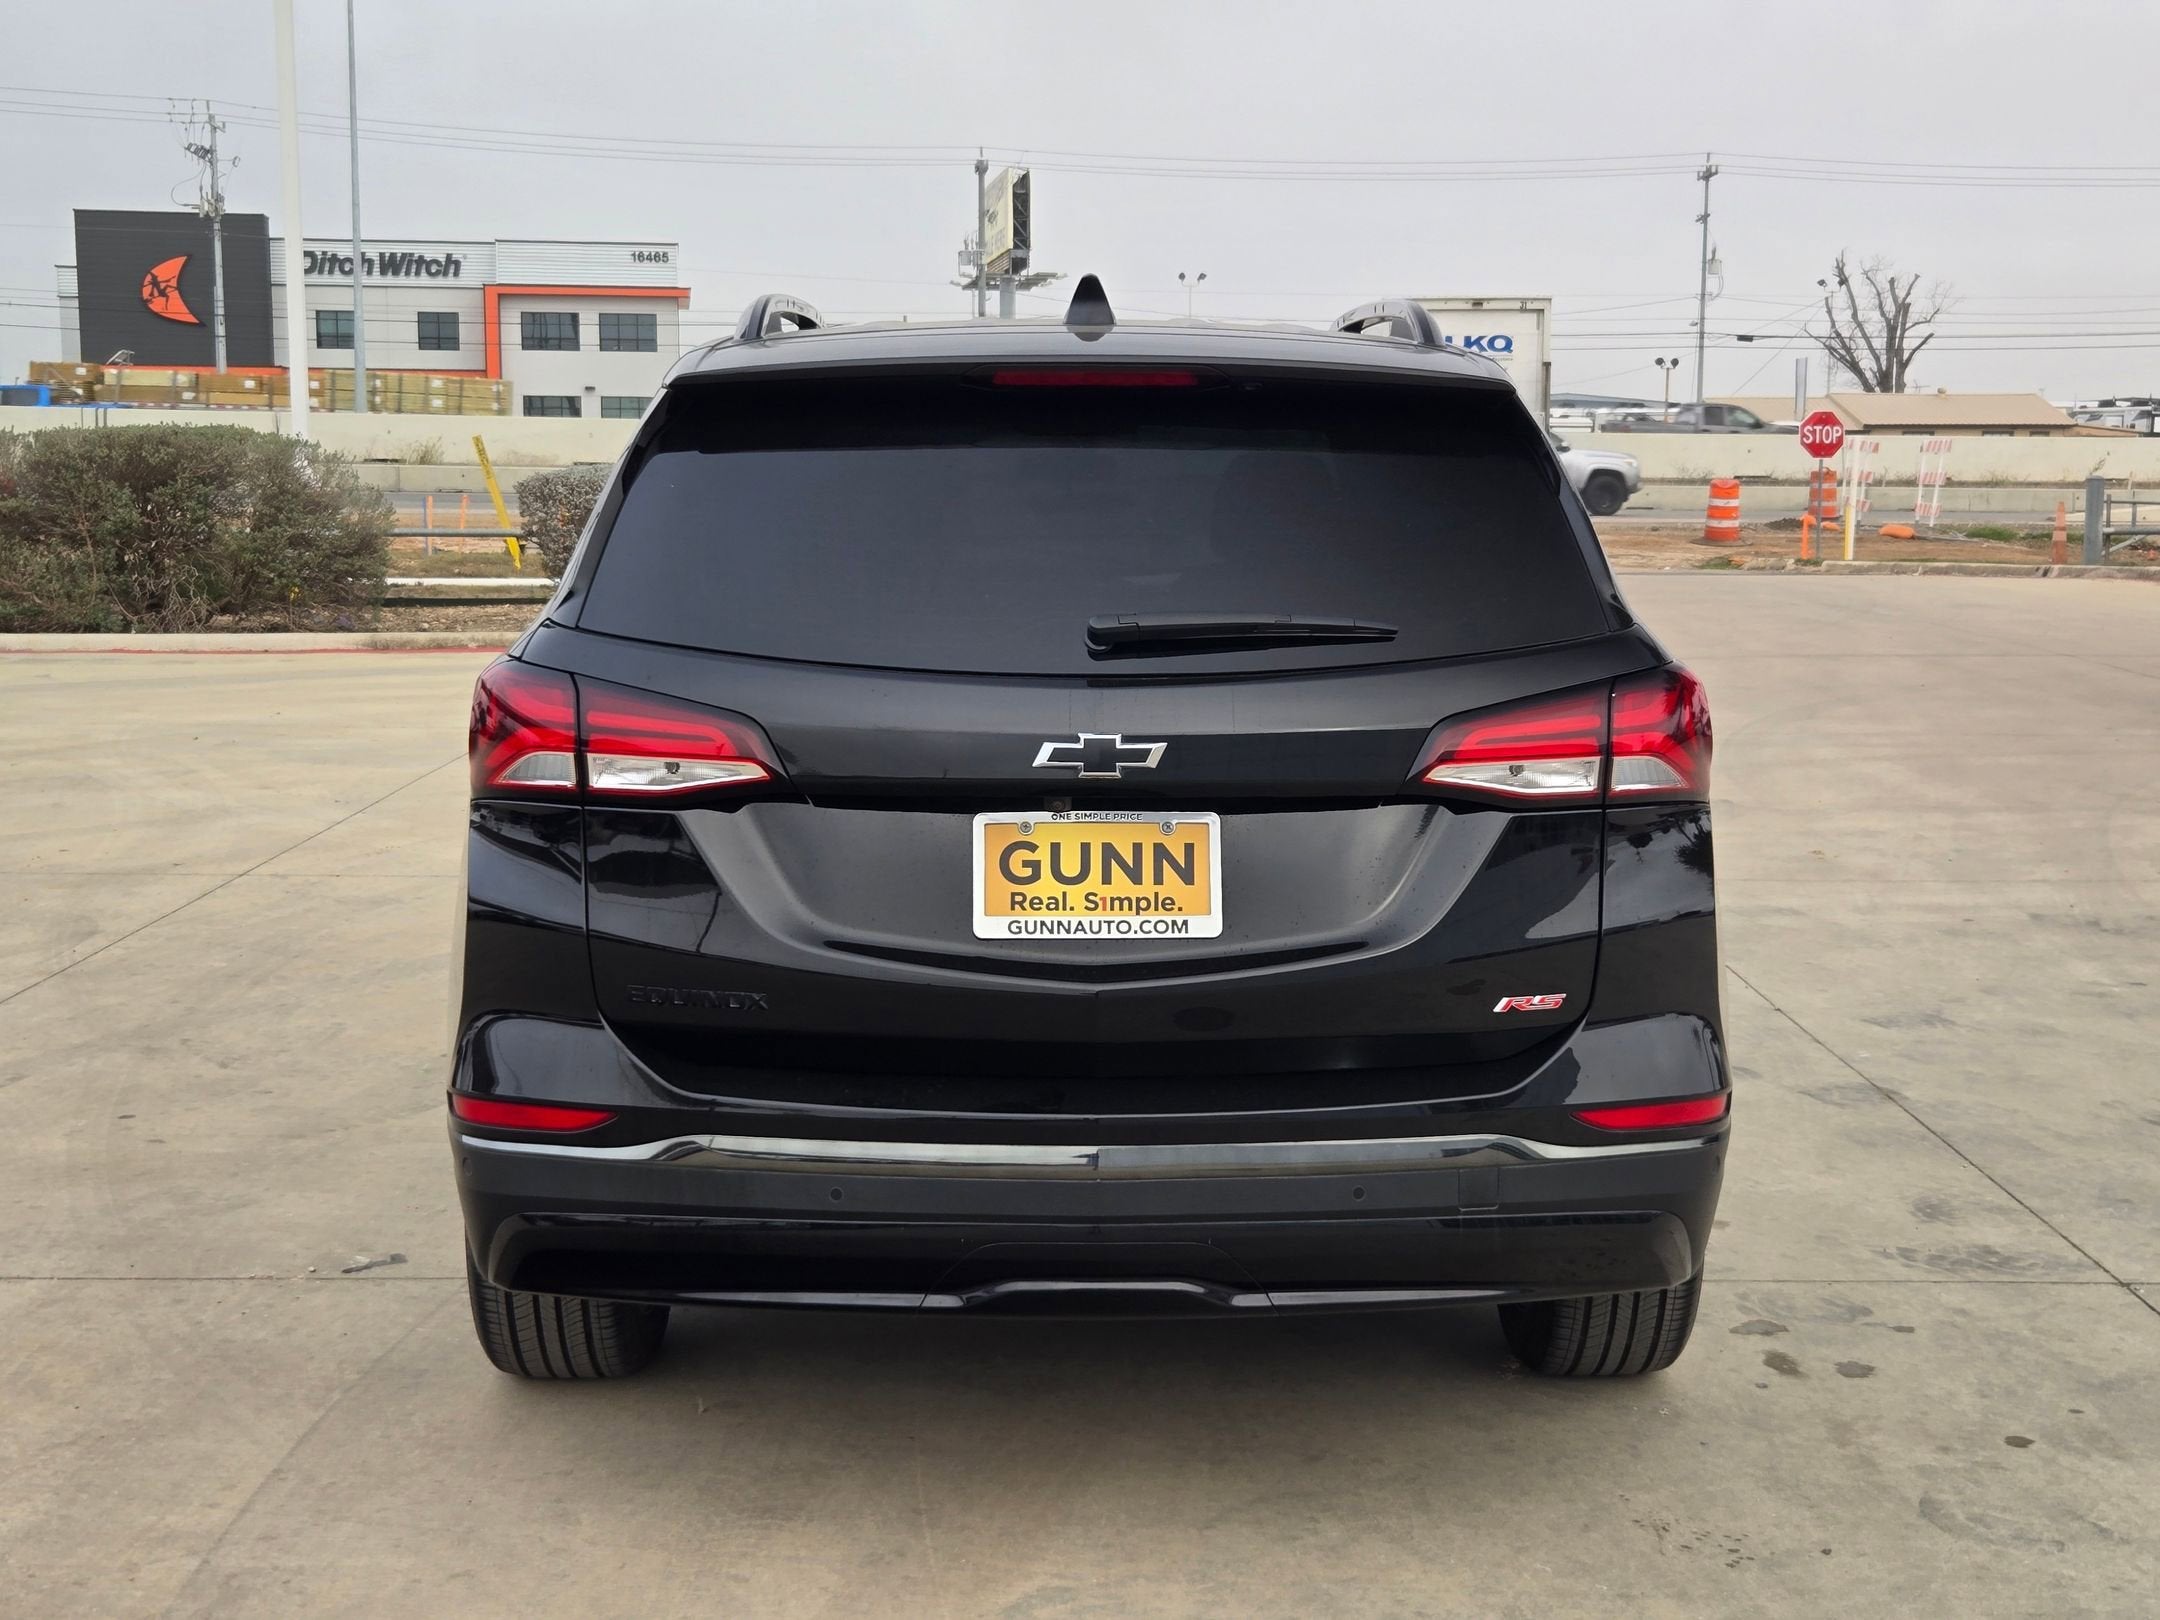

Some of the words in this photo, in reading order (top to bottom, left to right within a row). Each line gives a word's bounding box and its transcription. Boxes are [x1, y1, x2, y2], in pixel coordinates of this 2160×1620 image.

[303, 250, 375, 276] Ditch
[379, 251, 462, 277] Witch
[631, 250, 669, 263] 16465
[1802, 425, 1842, 444] STOP
[1051, 812, 1072, 821] ONE
[1074, 812, 1111, 821] SIMPLE
[1113, 813, 1143, 821] PRICE
[998, 840, 1195, 886] GUNN
[1010, 891, 1075, 912] Real.
[1007, 919, 1189, 935] GUNNAUTO.COM
[627, 984, 769, 1010] EQUINOX
[1493, 993, 1567, 1012] RS
